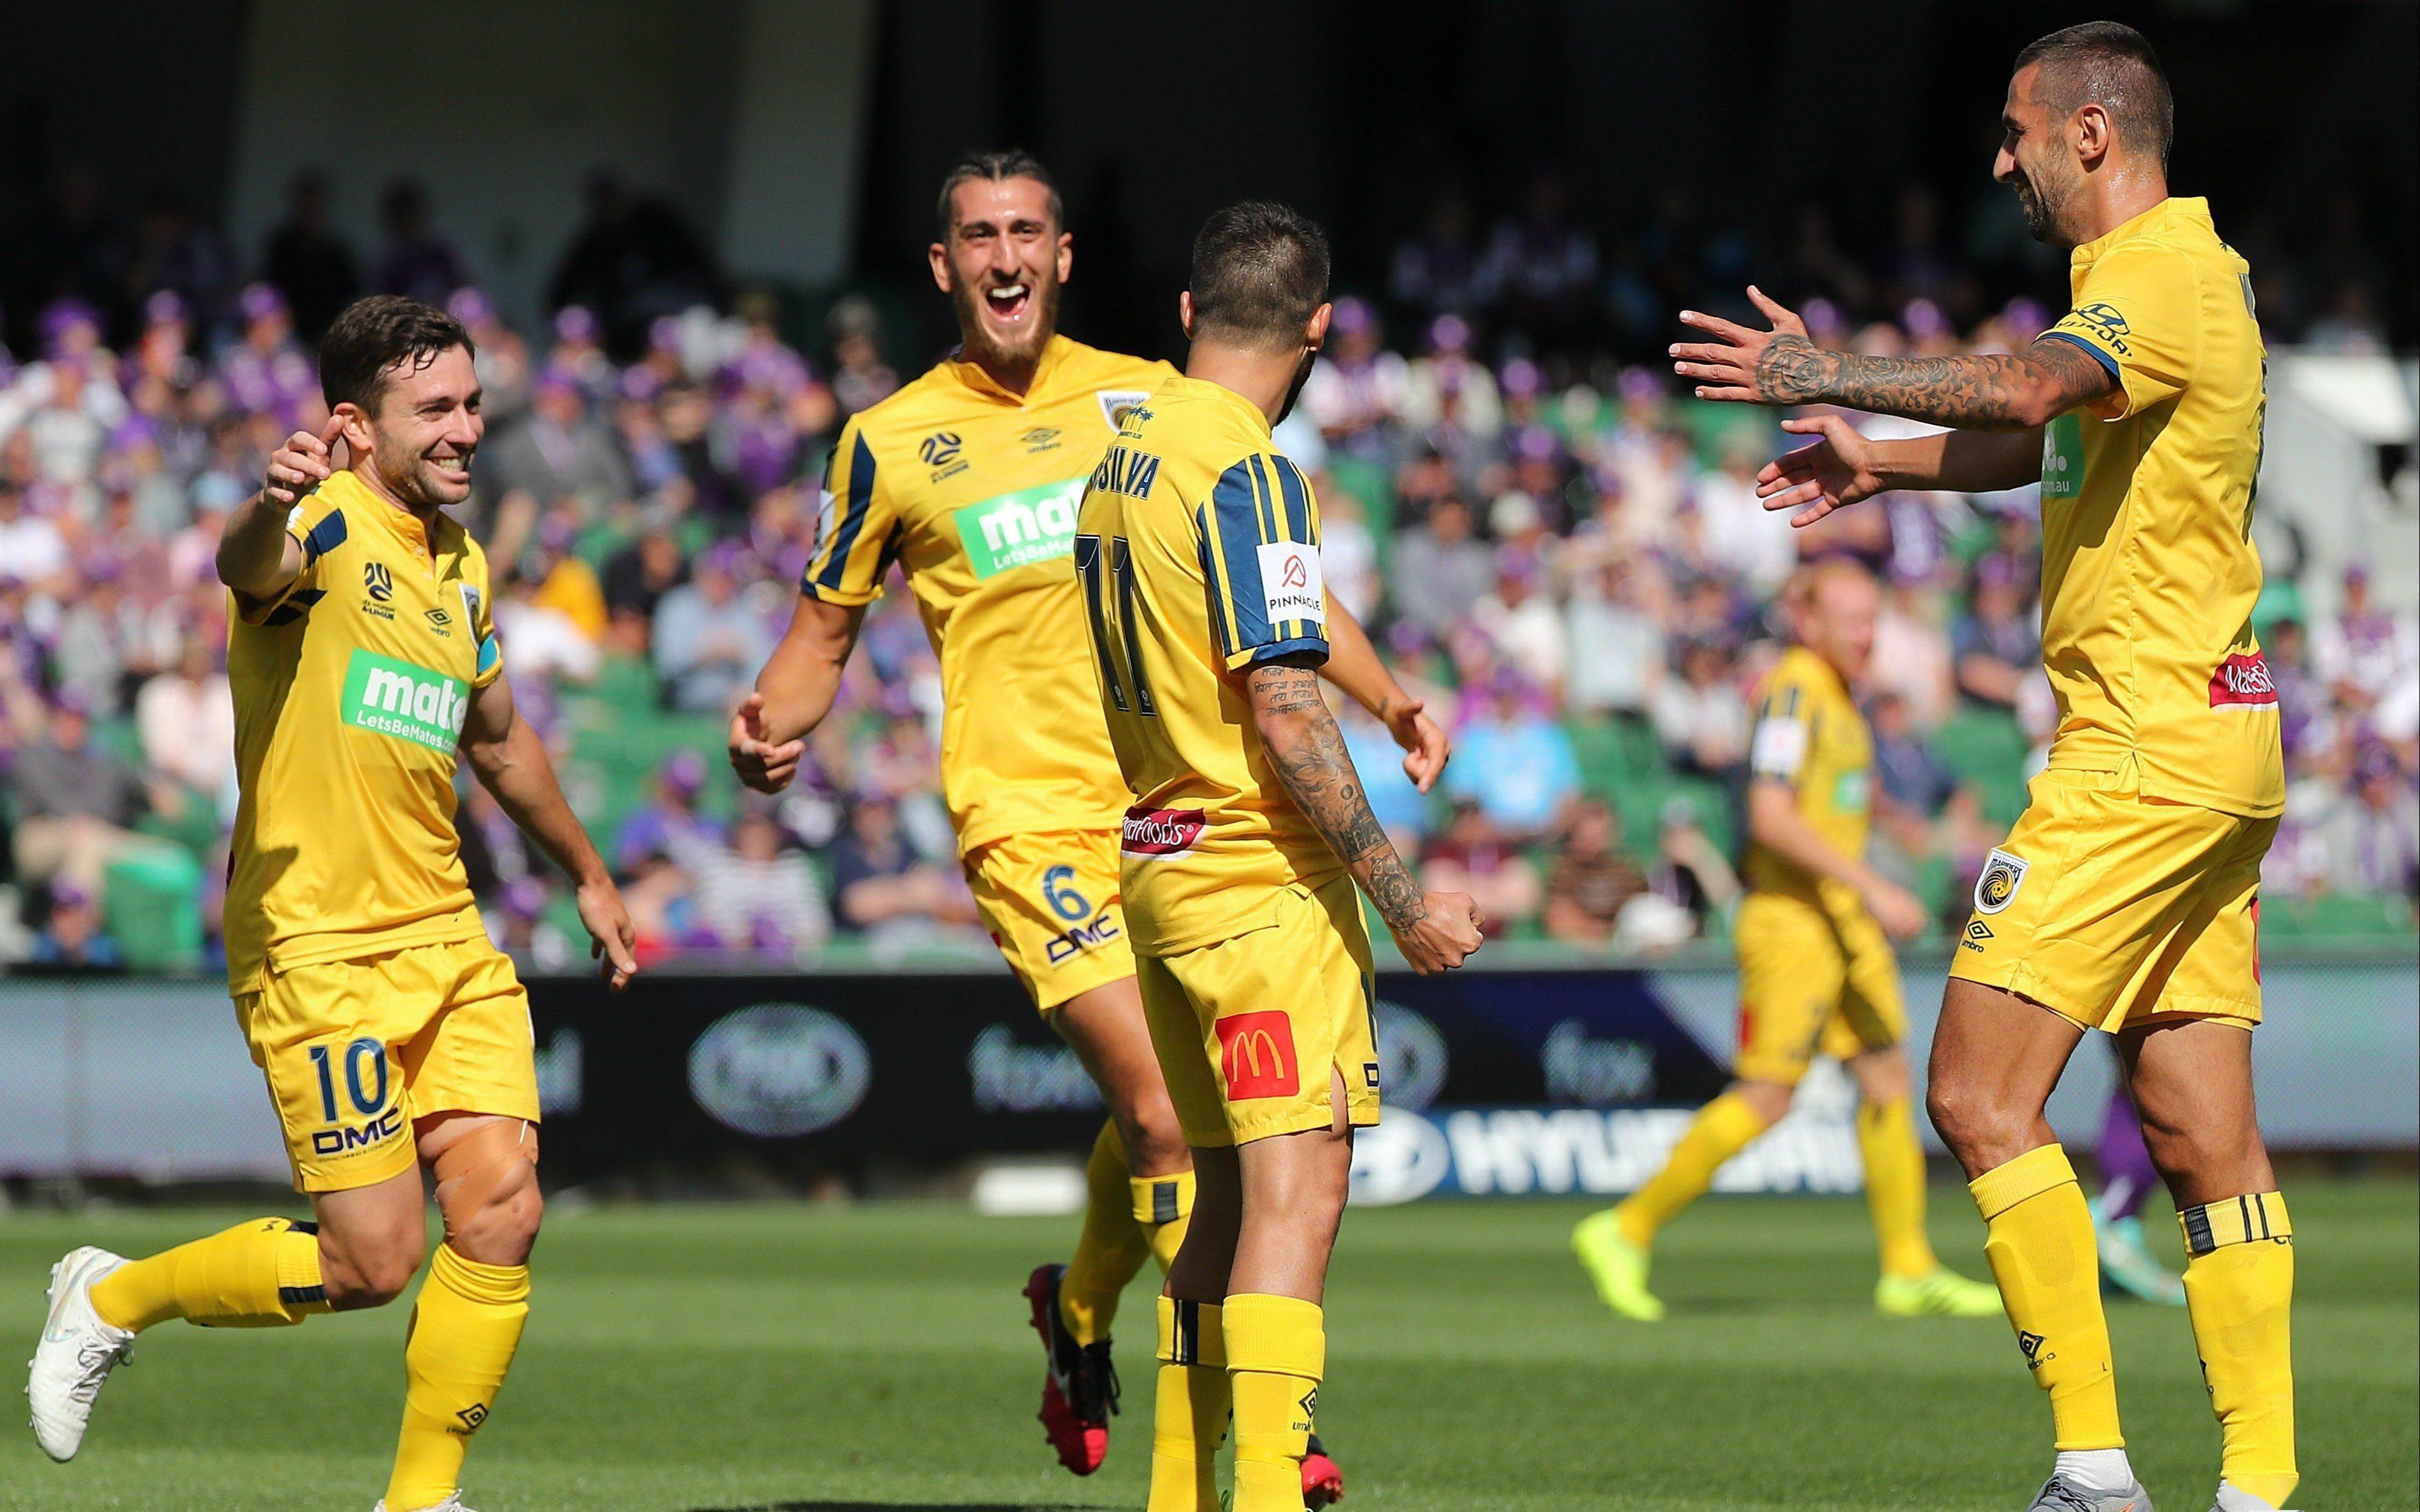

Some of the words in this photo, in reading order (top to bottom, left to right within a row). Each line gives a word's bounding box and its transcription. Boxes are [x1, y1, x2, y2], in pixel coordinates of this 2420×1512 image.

[1269, 594, 1321, 611] PINNACLE
[1042, 865, 1092, 921] 6
[1046, 915, 1119, 964] DMC
[308, 1037, 390, 1124] 10
[311, 1106, 403, 1154] DMC
